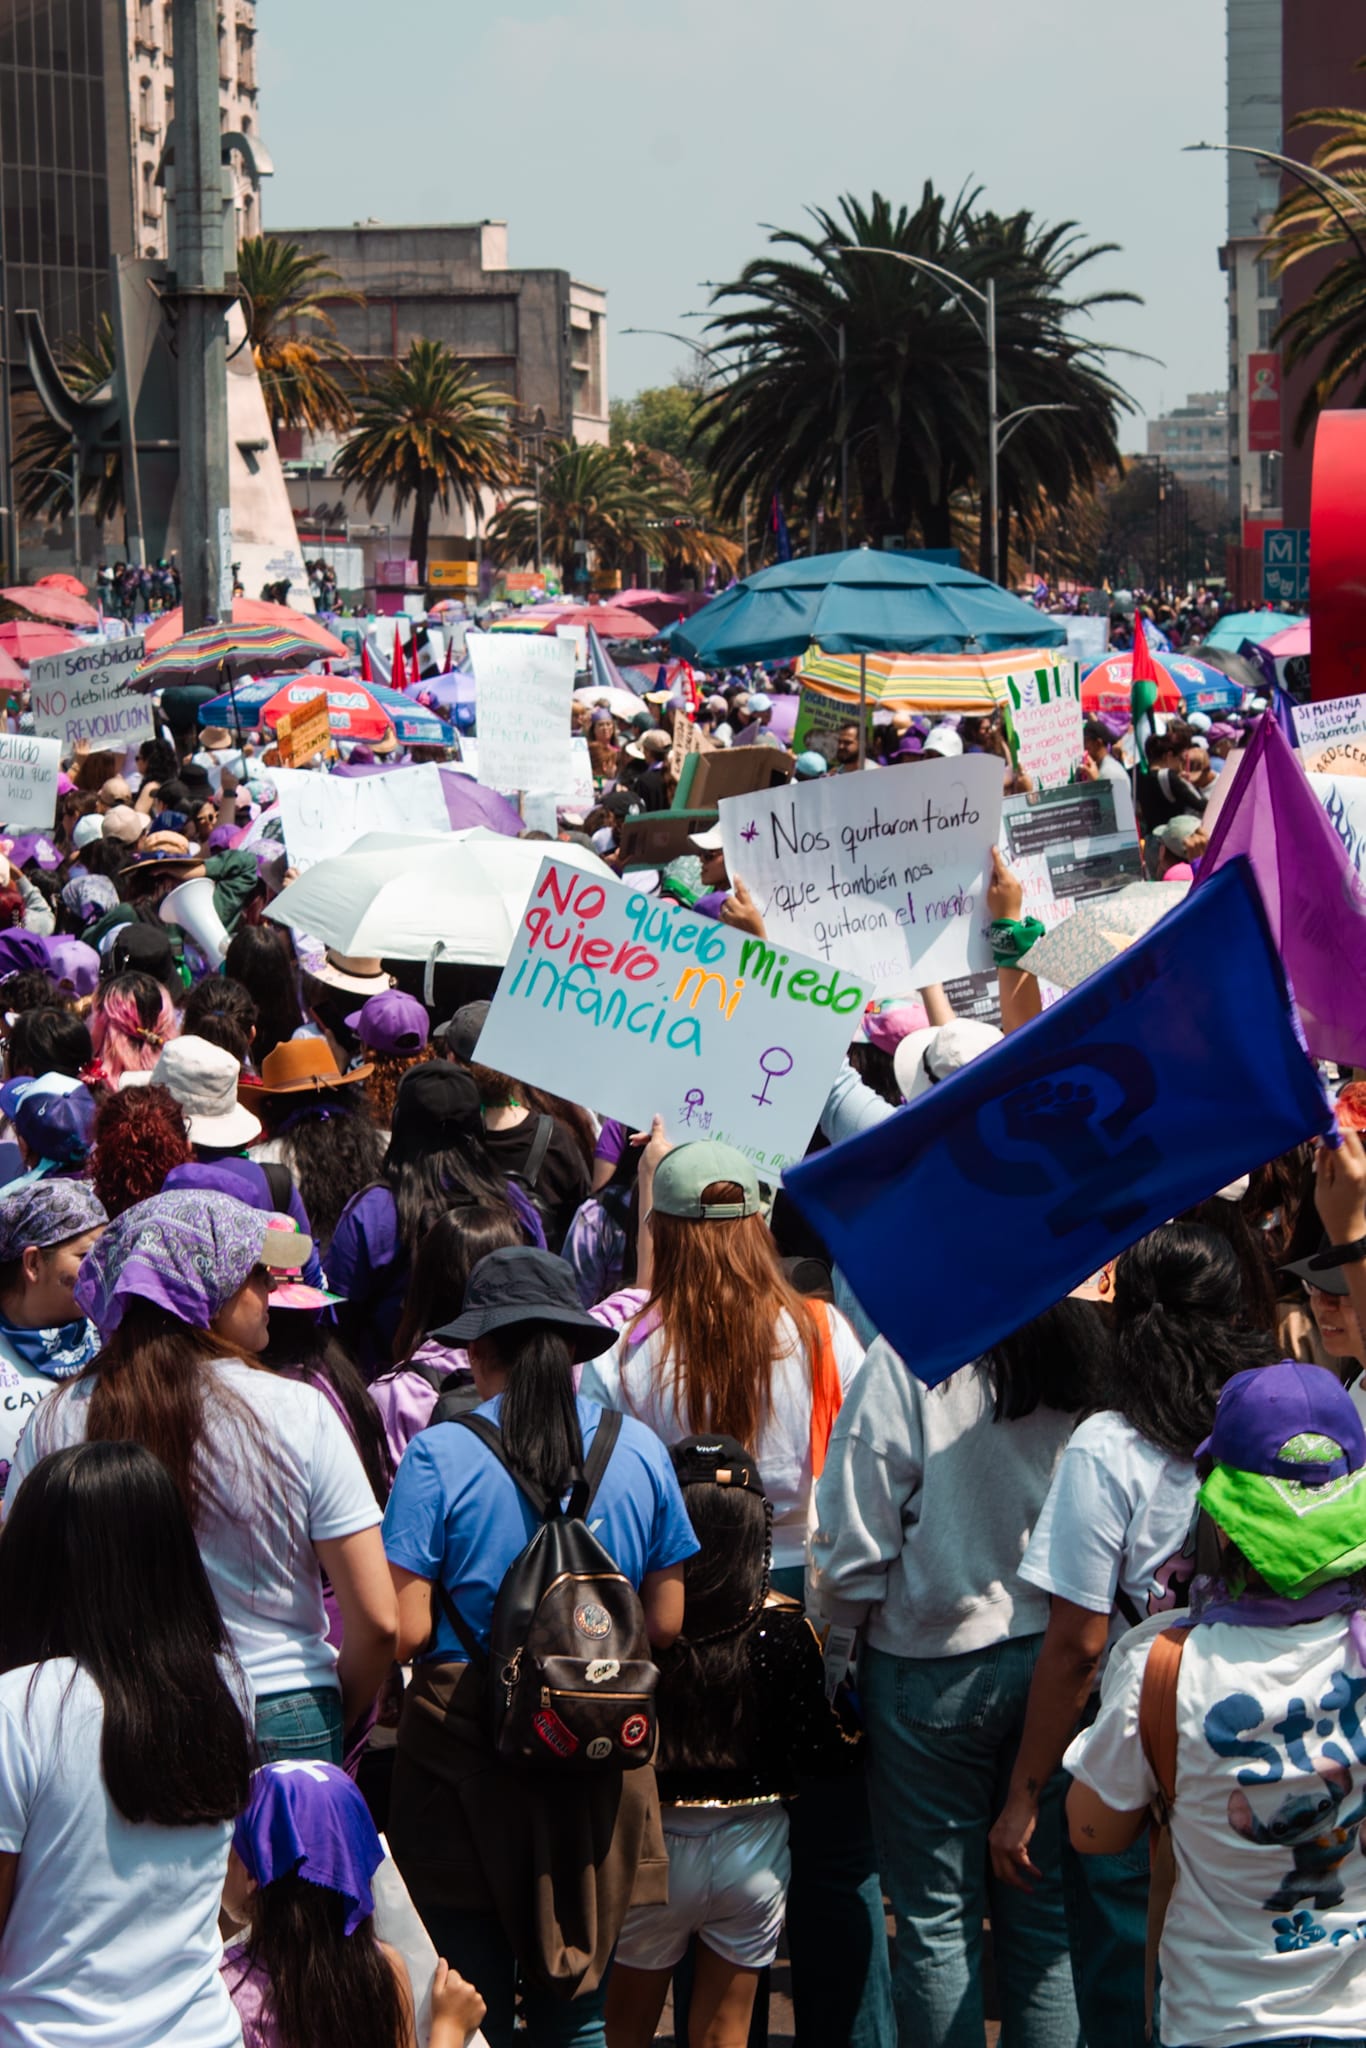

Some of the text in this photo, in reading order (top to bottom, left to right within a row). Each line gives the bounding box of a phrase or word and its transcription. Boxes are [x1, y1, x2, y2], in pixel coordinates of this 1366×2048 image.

[36, 690, 66, 718] NO
[90, 671, 110, 685] es
[8, 781, 33, 801] hizo
[770, 801, 831, 859] Nos
[841, 807, 918, 864] quitaron
[922, 797, 980, 834] tanto
[537, 866, 606, 919] NO
[625, 894, 726, 964] quiero
[776, 862, 934, 922] que también nos
[814, 903, 888, 961] quitaron
[895, 891, 916, 926] el
[525, 907, 746, 1022] quiero mi
[508, 948, 702, 1057] infancia
